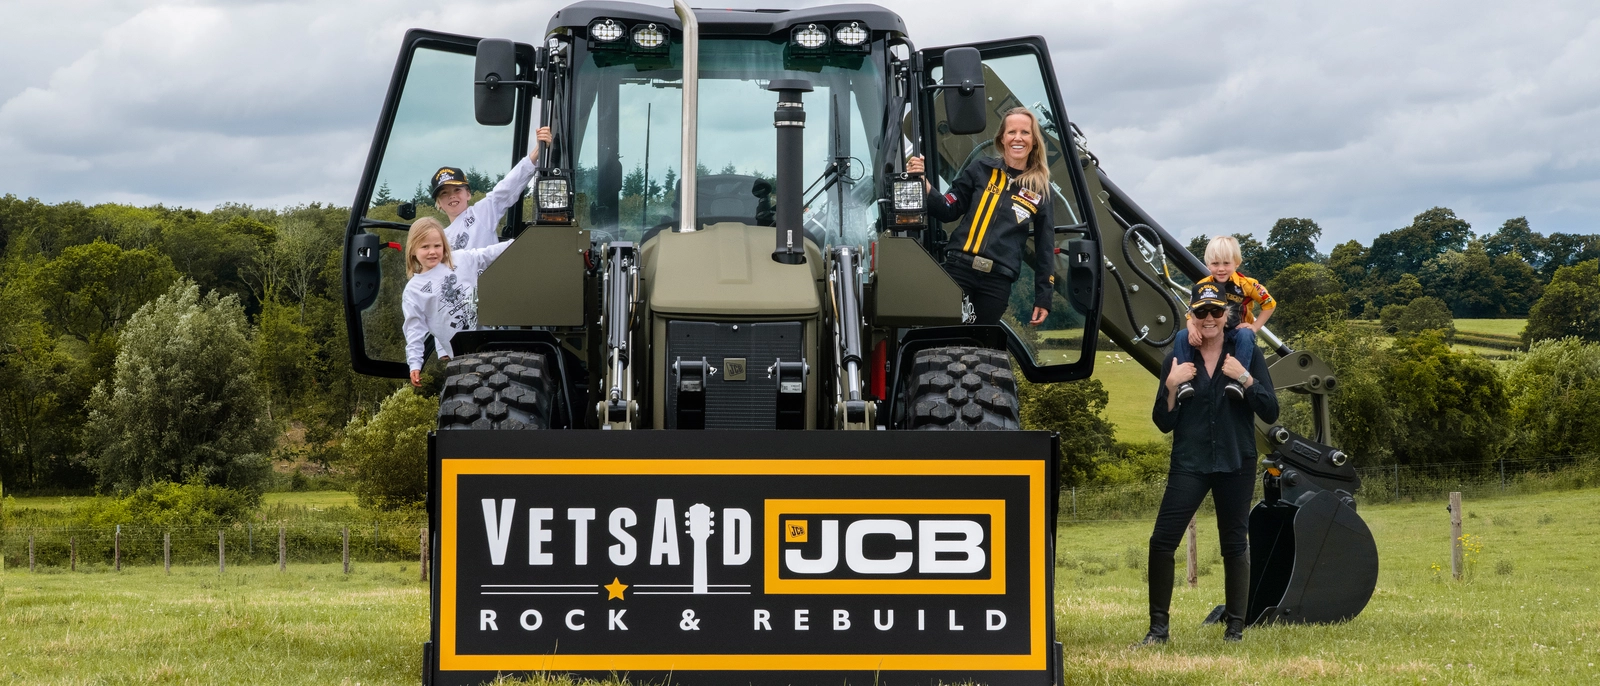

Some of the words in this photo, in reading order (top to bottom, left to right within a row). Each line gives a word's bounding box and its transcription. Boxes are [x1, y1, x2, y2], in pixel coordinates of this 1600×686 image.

[729, 362, 745, 376] JCB
[791, 525, 805, 537] JCB
[785, 519, 986, 574] JCB
[479, 608, 629, 631] ROCK
[679, 608, 701, 631] &
[753, 609, 1007, 631] REBUILD
